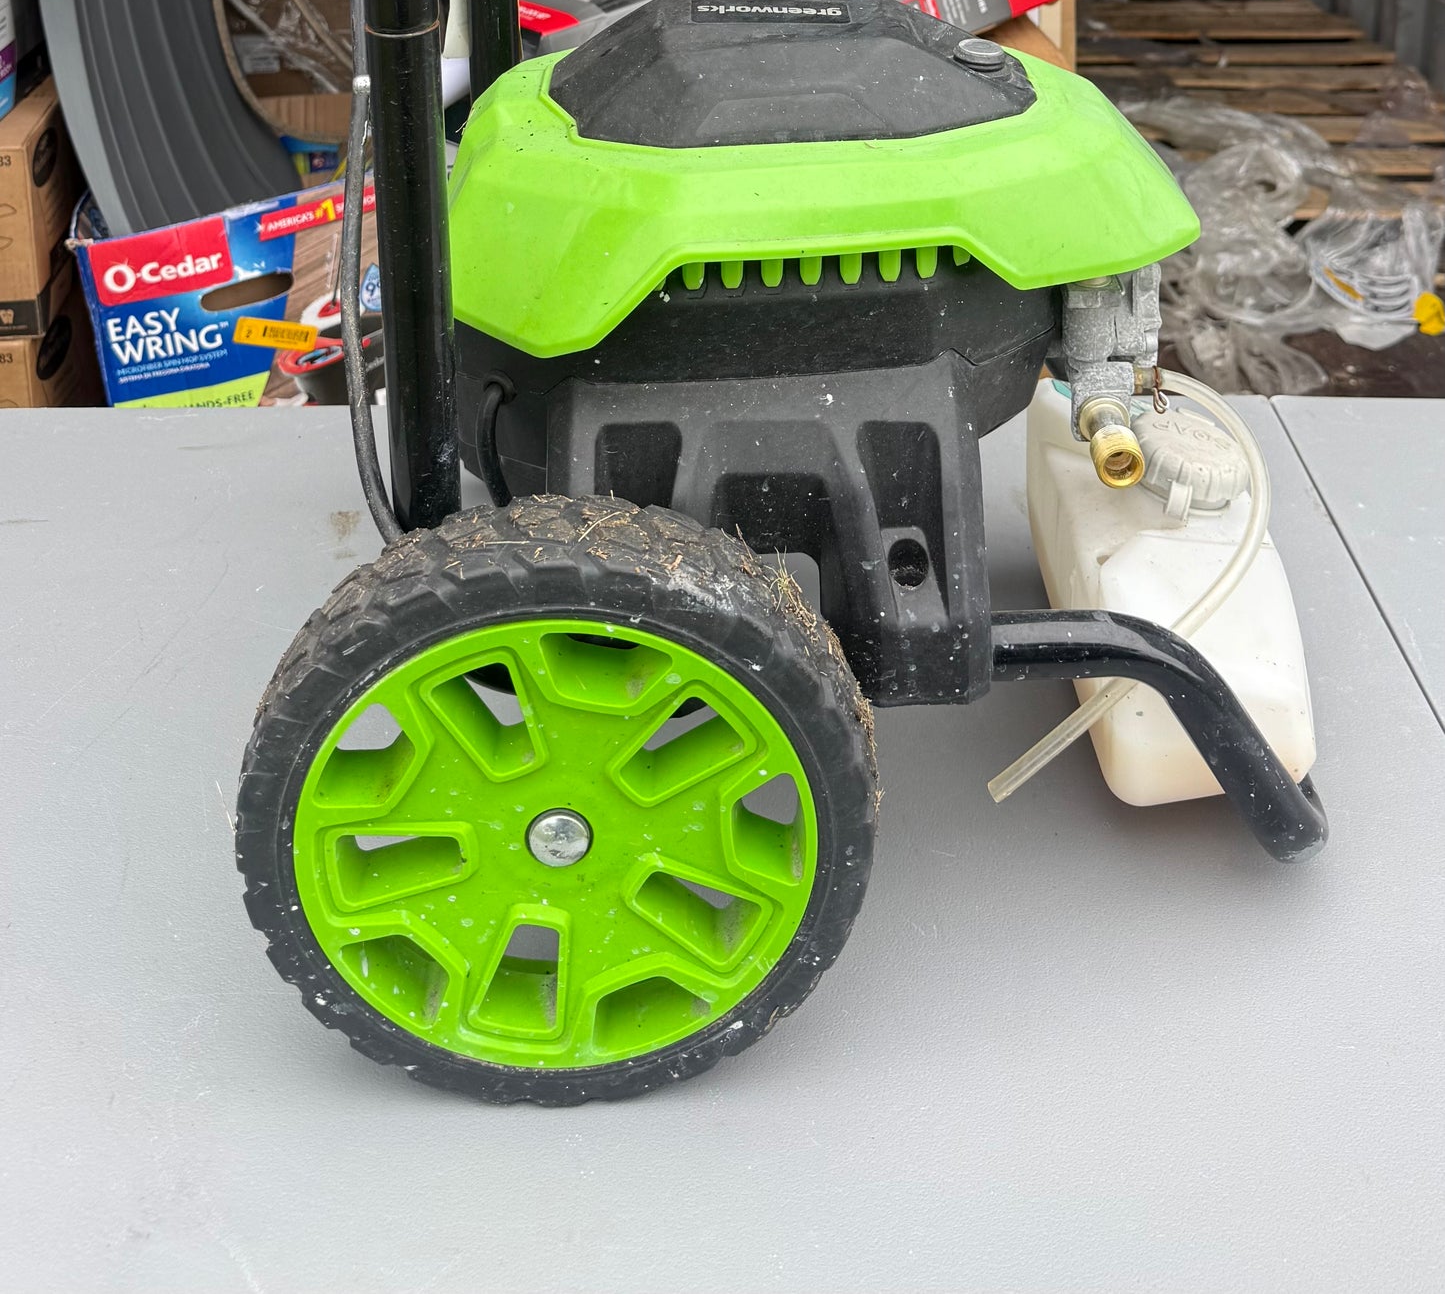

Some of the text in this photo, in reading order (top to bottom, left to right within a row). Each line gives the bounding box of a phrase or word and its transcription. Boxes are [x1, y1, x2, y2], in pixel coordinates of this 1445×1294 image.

[698, 6, 842, 16] greenworks
[267, 211, 314, 231] AMERICA'S
[315, 198, 335, 222] #1
[104, 252, 222, 293] O-Cedar
[107, 307, 180, 343] EASY
[184, 390, 255, 407] NDS-FREE
